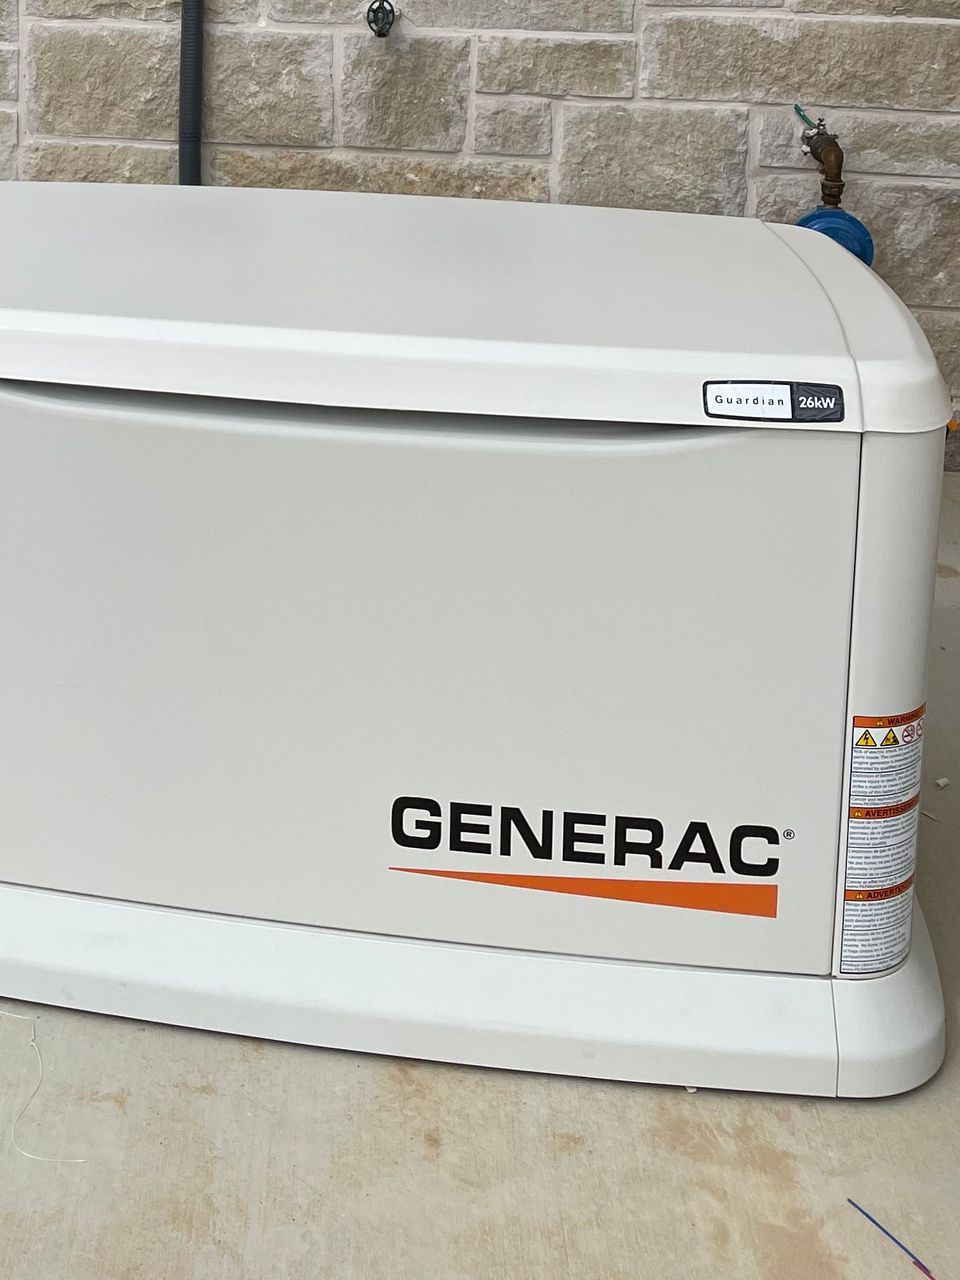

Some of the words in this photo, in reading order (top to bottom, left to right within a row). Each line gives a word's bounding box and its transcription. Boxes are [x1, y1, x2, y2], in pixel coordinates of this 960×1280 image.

[715, 395, 784, 406] Guardian
[799, 397, 835, 409] 26kW
[865, 799, 919, 817] AVERTISSE
[391, 796, 780, 877] GENERAC
[867, 879, 912, 900] ADVERTE
